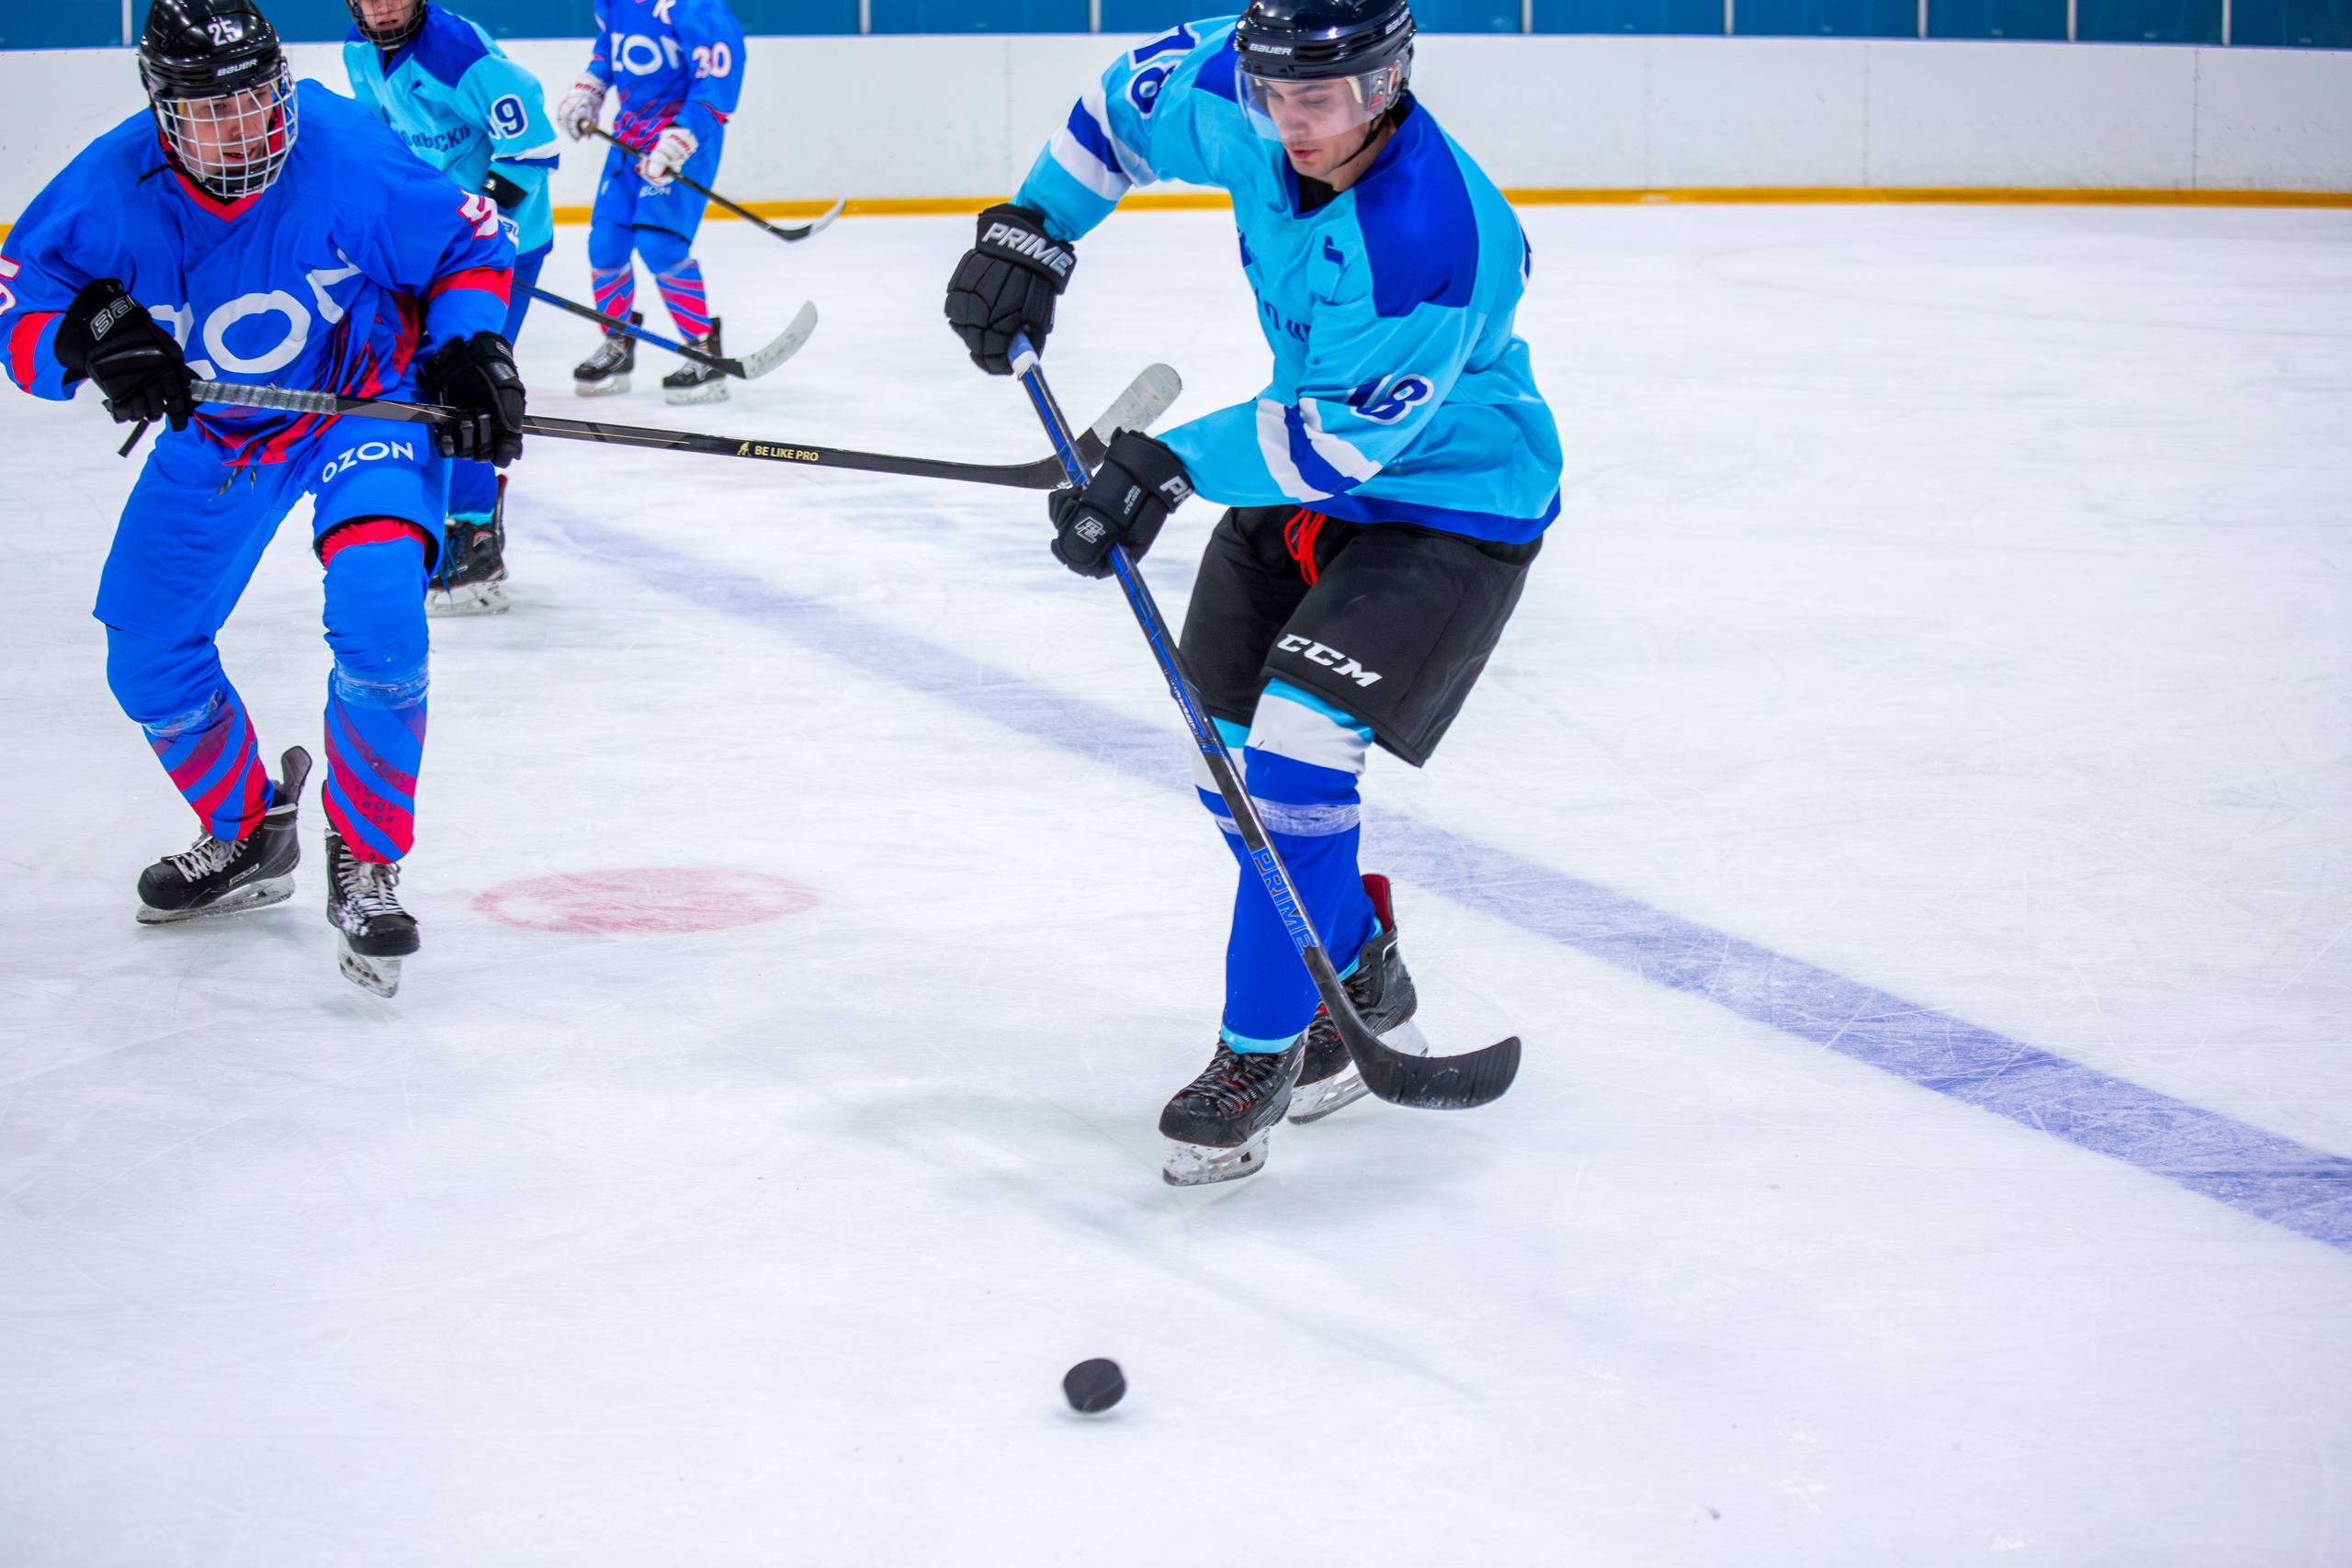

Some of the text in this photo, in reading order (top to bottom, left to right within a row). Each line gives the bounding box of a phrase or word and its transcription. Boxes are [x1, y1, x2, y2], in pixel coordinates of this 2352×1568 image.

[207, 20, 244, 46] 25
[1250, 43, 1293, 56] BAUER
[217, 58, 258, 76] BAUER
[692, 41, 732, 78] 30
[981, 222, 1074, 277] PRIME
[322, 441, 413, 483] OZON
[754, 446, 819, 462] BE LIKE PRO
[1277, 634, 1383, 687] CCM
[1250, 846, 1319, 956] PRIME
